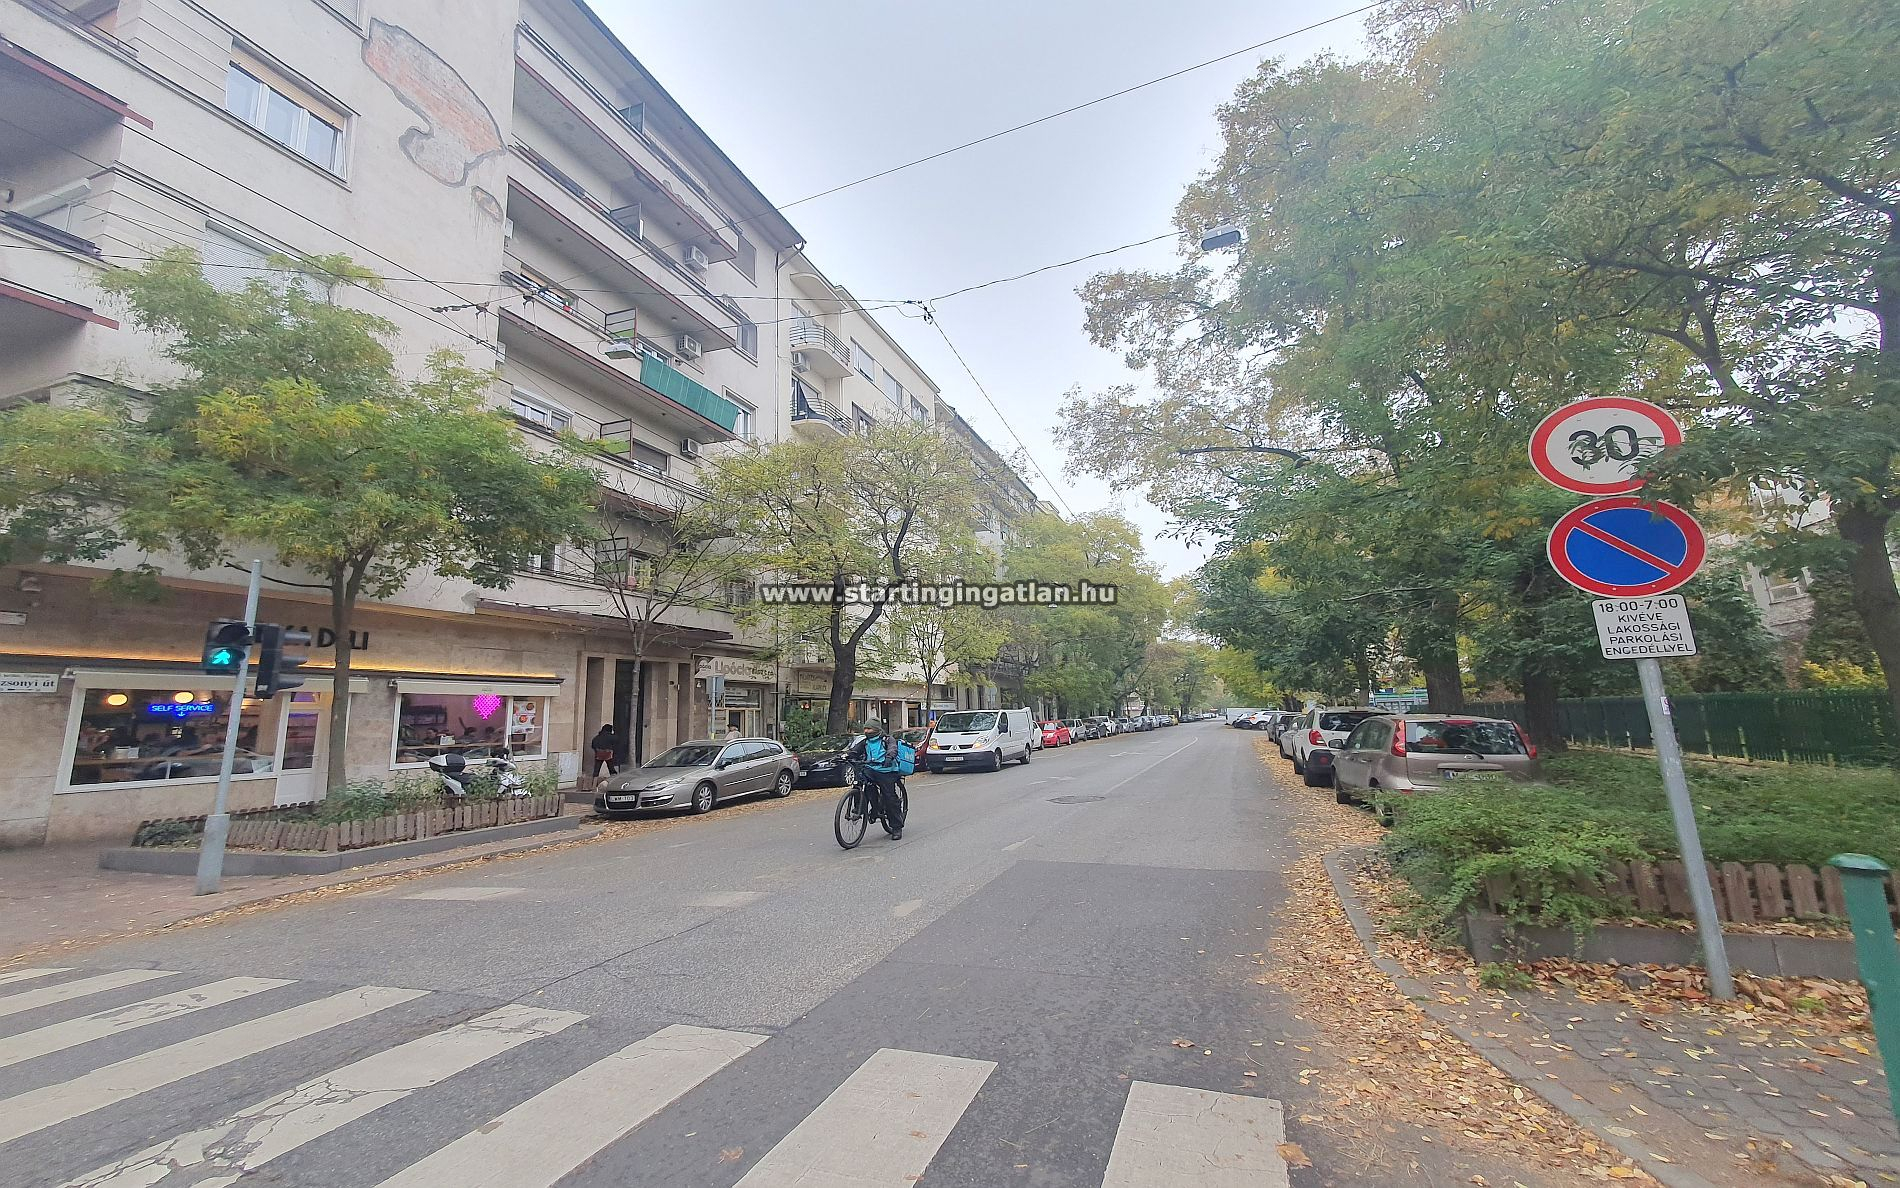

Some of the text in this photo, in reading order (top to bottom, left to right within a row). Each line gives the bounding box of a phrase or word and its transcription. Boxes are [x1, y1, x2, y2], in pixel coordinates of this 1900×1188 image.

[1569, 425, 1640, 465] 30
[1618, 612, 1663, 622] KIVÉVE
[1607, 621, 1680, 634] LAKOSSÁGI
[317, 627, 369, 650] DLI
[1610, 632, 1683, 644] PARKOLÁSI
[175, 704, 213, 712] SERVICE
